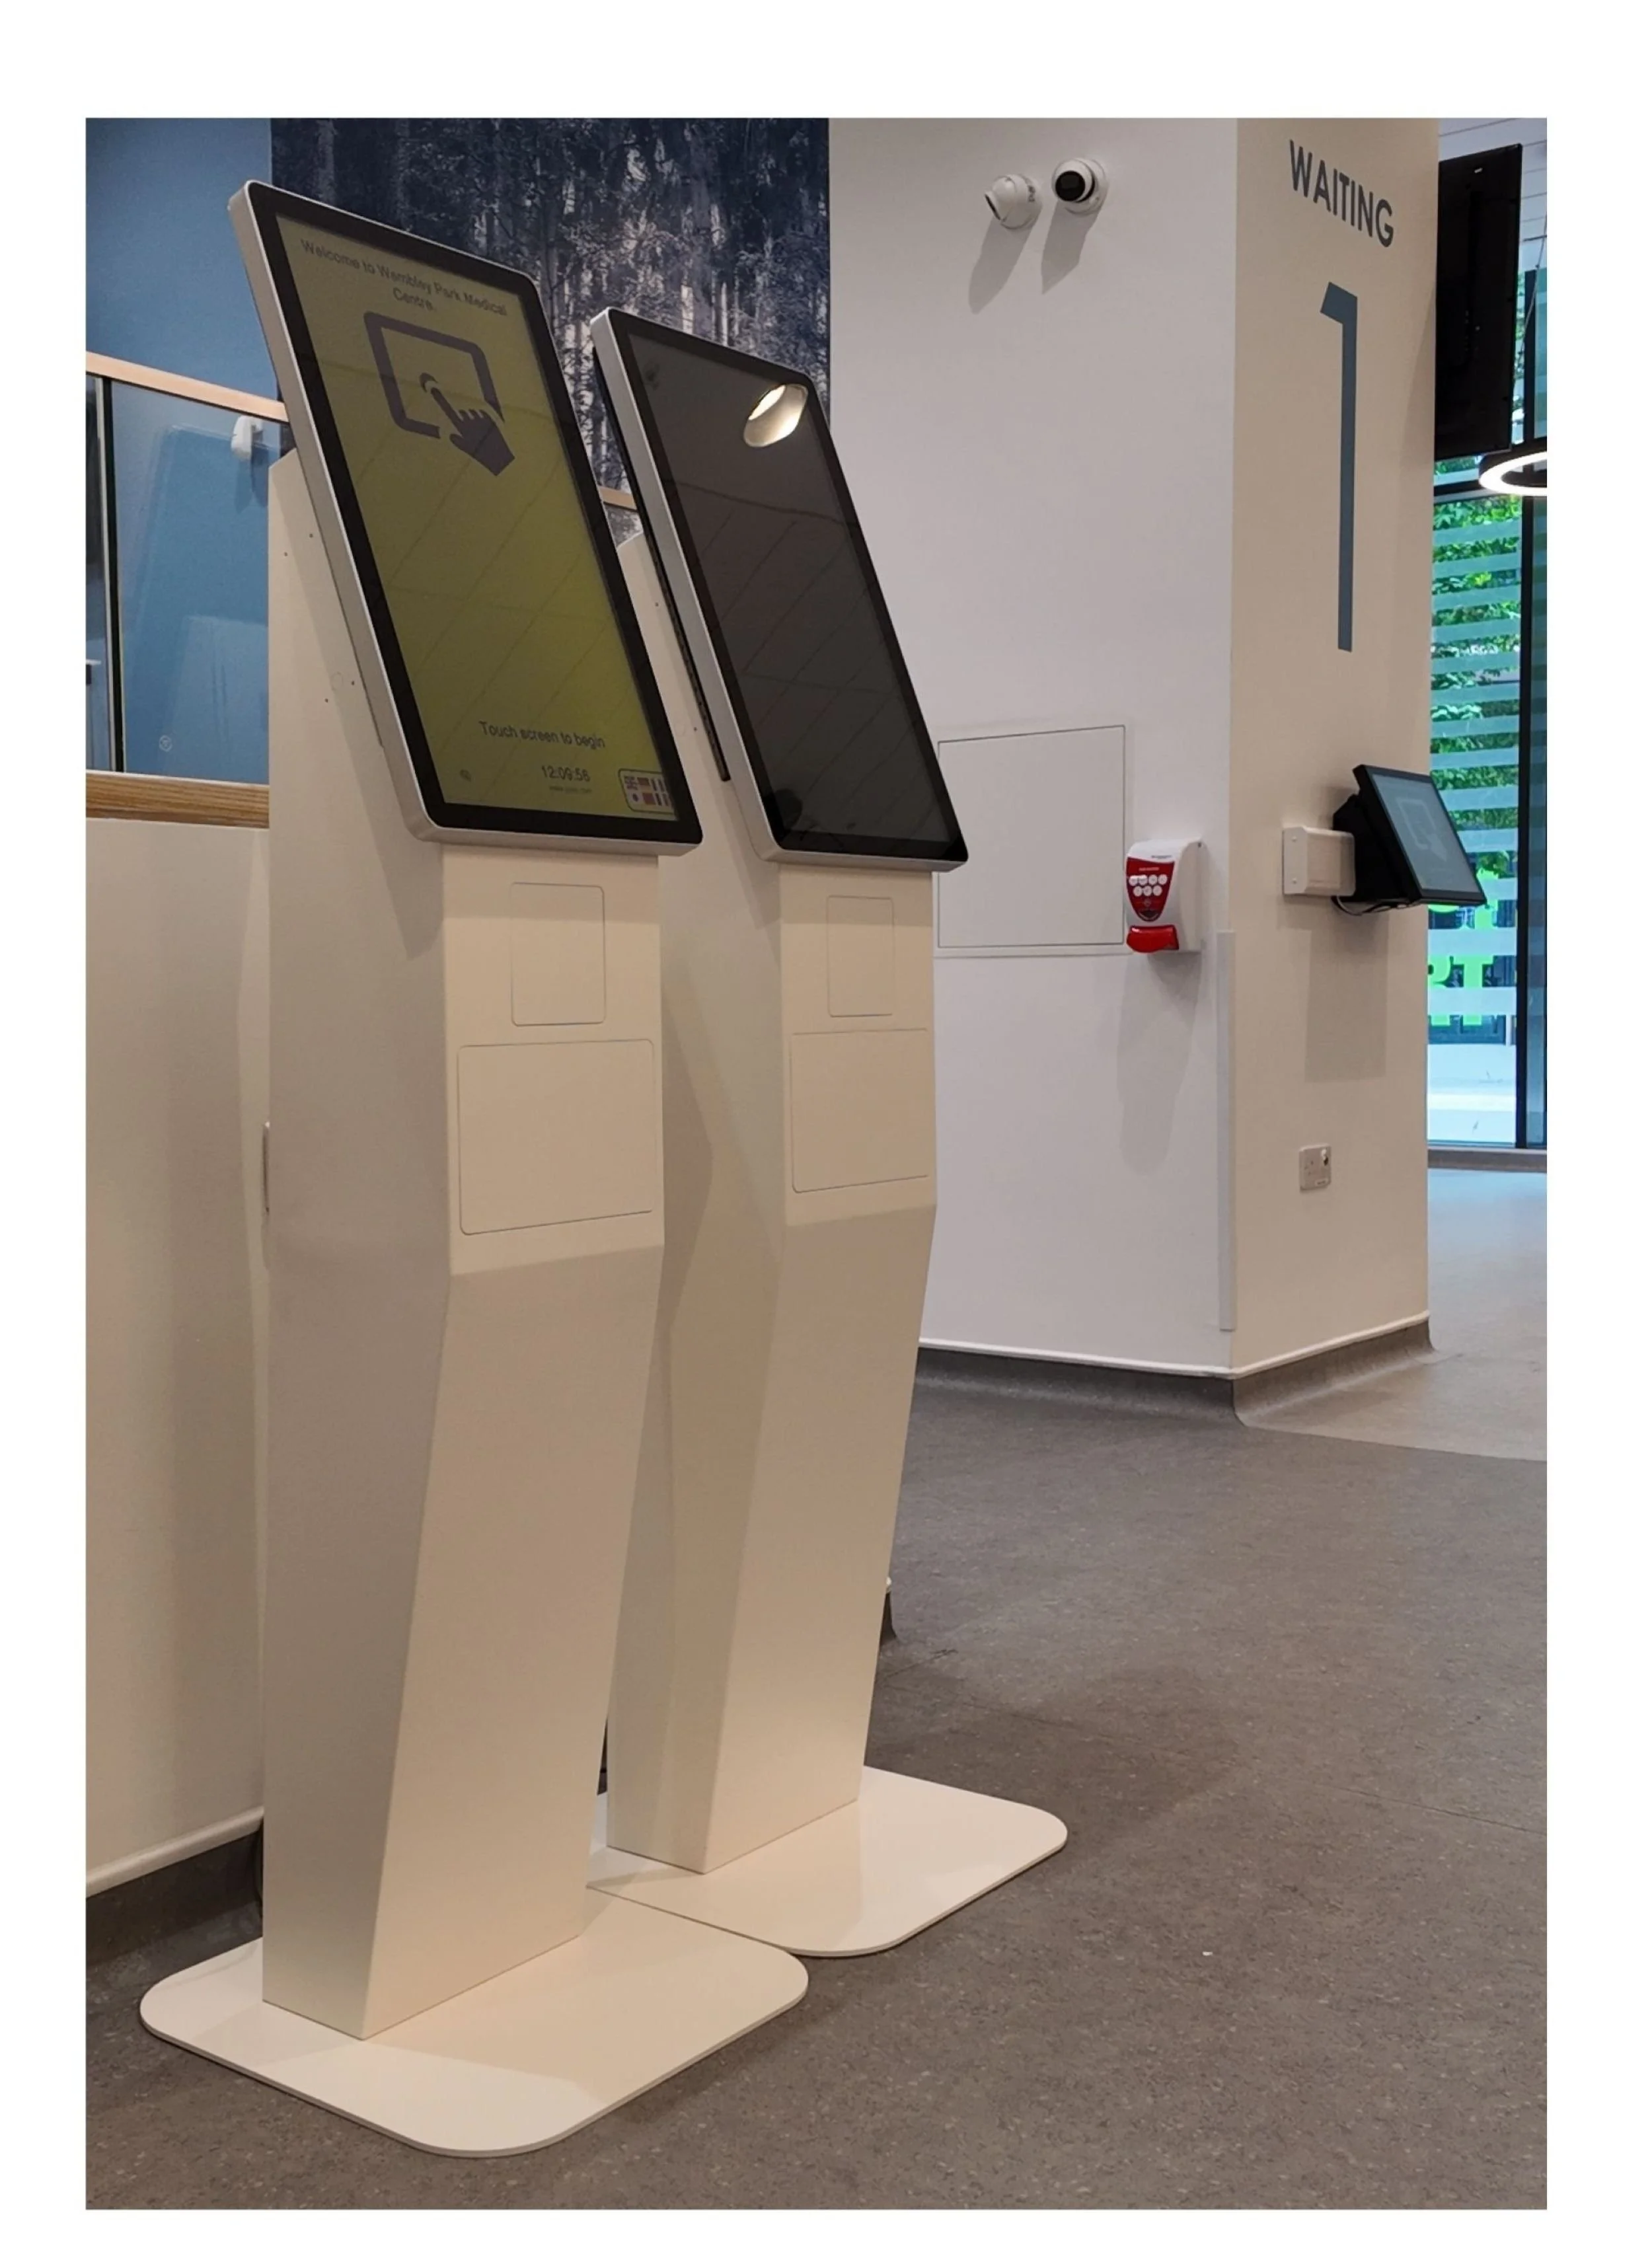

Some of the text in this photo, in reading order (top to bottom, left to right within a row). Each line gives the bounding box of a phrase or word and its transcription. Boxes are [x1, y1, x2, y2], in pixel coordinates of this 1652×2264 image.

[1289, 139, 1394, 247] WAITING
[300, 239, 507, 316] Welcome to Wembley Park Medical
[1320, 282, 1358, 652] 1
[478, 720, 606, 750] Touch screen to begin
